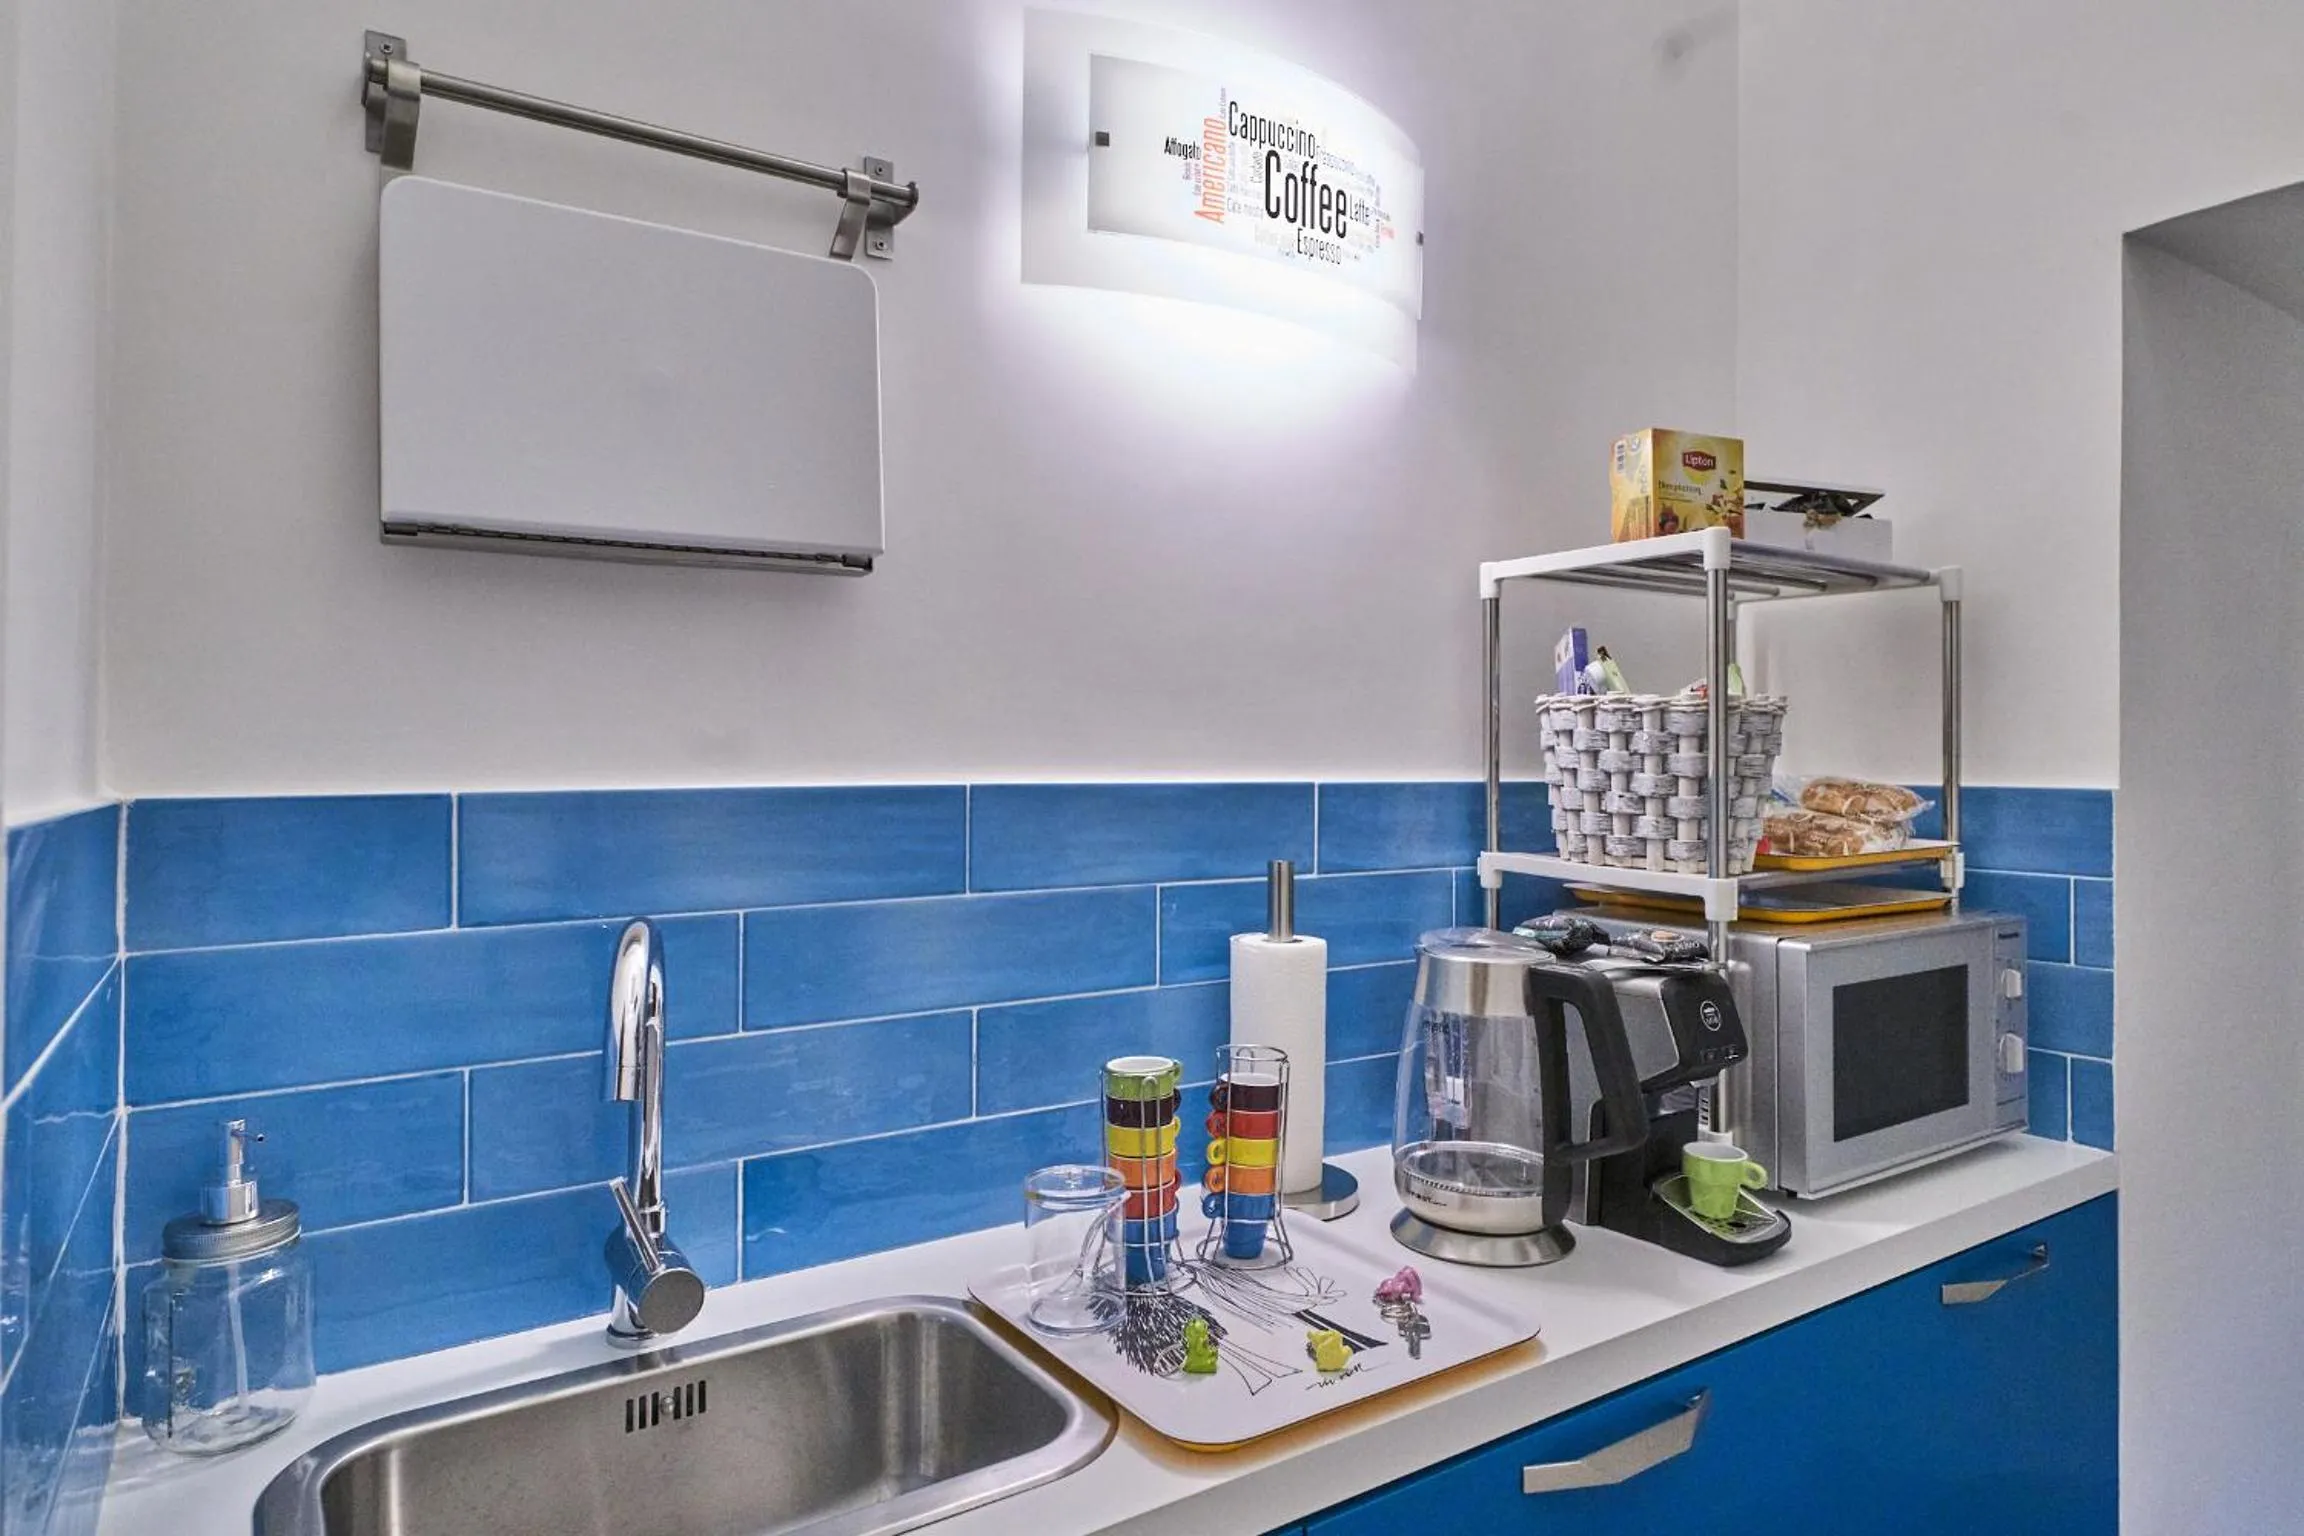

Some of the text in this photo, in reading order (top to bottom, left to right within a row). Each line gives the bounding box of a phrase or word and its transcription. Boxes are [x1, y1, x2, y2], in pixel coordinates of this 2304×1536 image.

[1228, 101, 1316, 159] Cappuccino
[1194, 117, 1227, 224] Americano
[1265, 150, 1347, 238] Coffee
[1350, 194, 1370, 226] Latte
[1297, 228, 1342, 265] Espresso
[1685, 453, 1714, 468] Lipton
